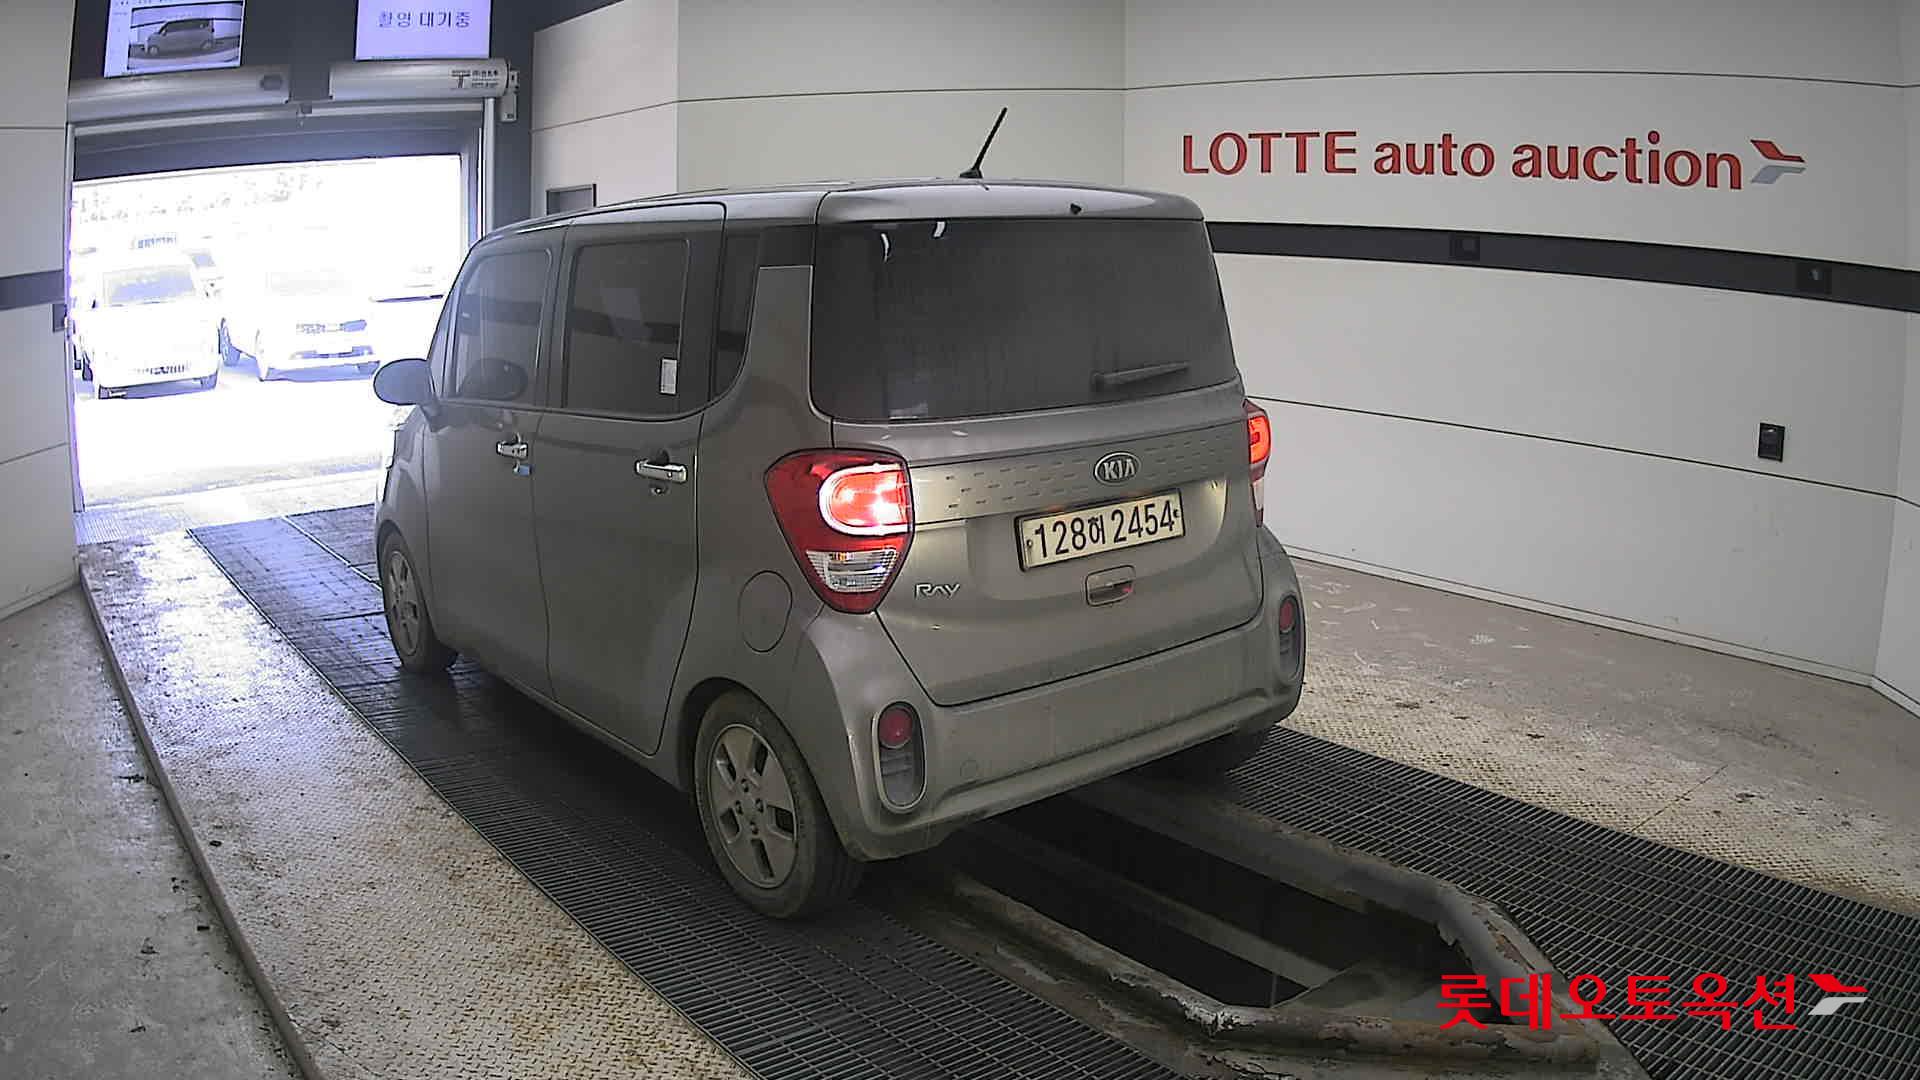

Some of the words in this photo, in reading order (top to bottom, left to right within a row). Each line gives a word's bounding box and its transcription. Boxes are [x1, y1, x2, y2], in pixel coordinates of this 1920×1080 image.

[419, 11, 472, 28] 대기중
[1183, 131, 1358, 175] LOTTE
[1374, 133, 1496, 176] auto
[1512, 131, 1743, 190] auction
[1103, 458, 1136, 480] KIA
[1034, 514, 1106, 559] 128허
[1111, 499, 1175, 544] 2454
